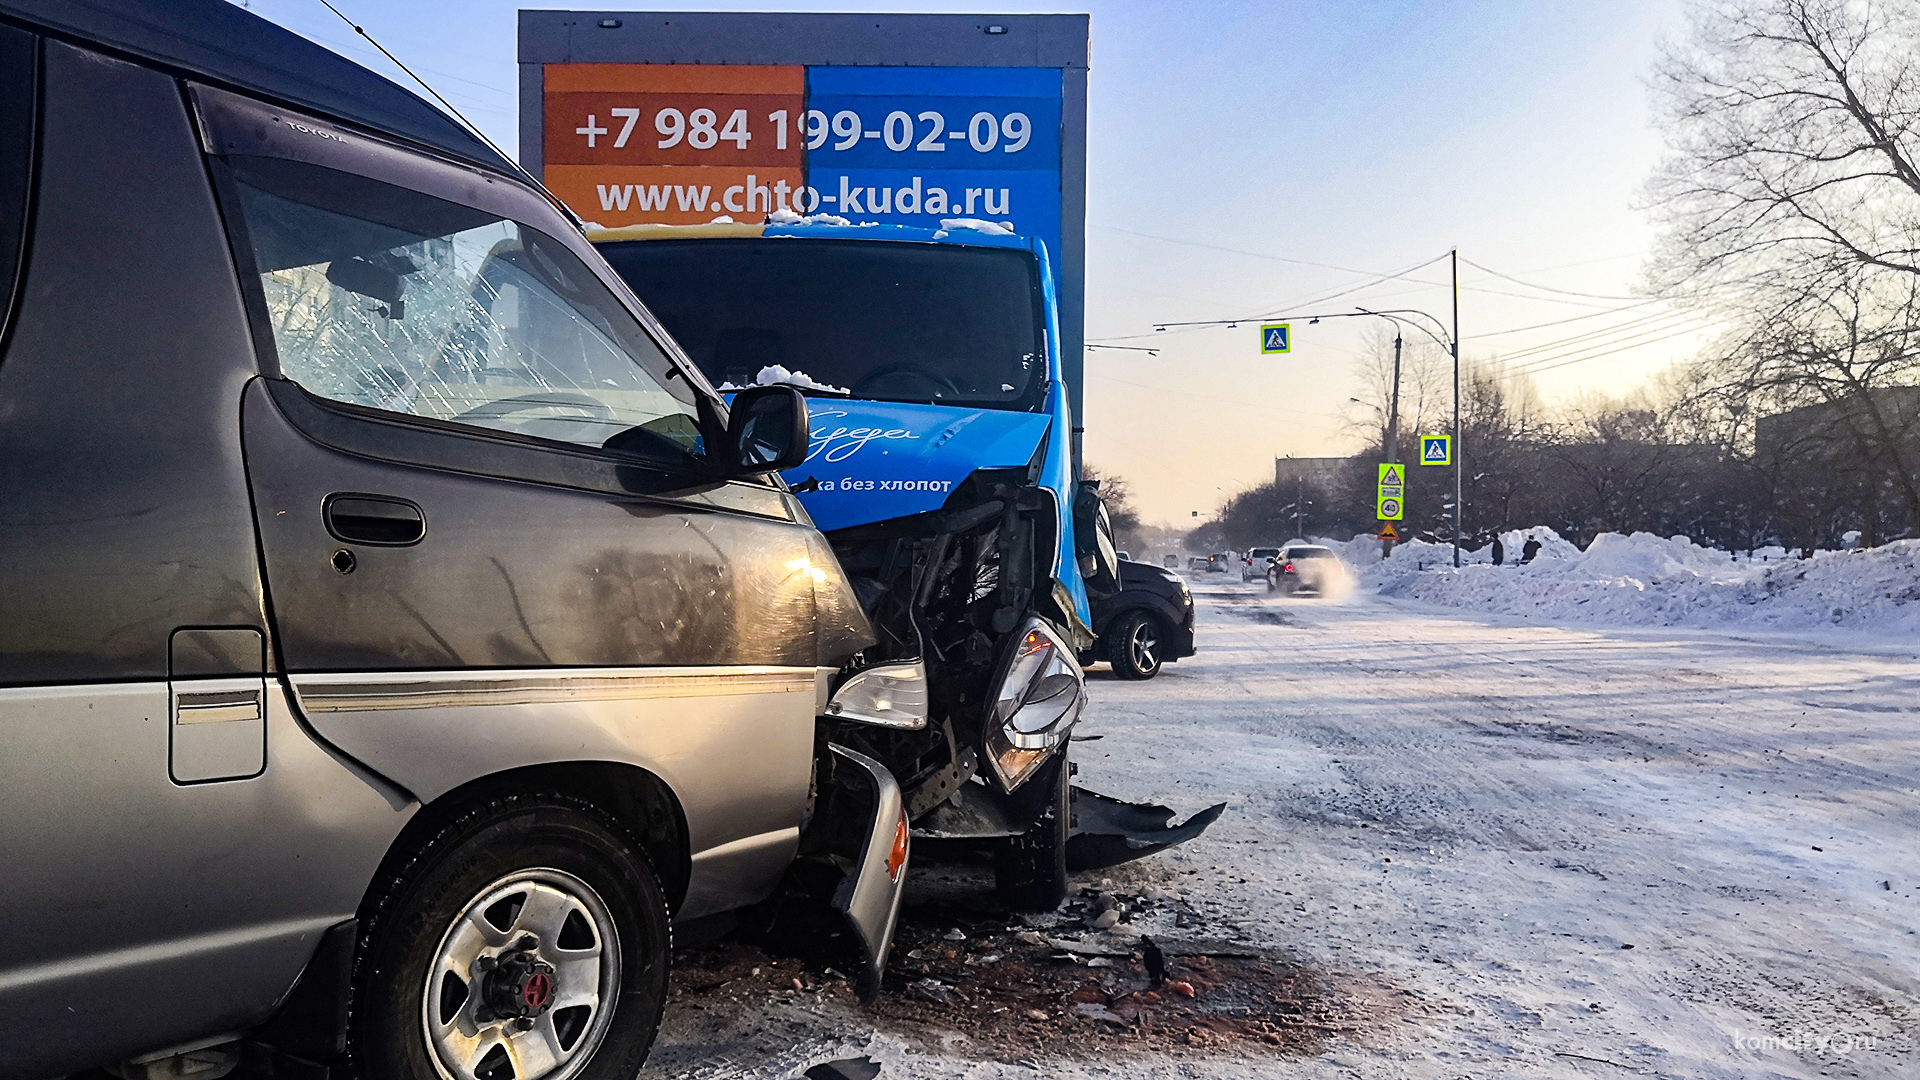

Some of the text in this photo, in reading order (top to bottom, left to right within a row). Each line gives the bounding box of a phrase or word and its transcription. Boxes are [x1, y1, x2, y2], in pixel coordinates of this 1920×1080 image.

[286, 121, 349, 144] TOYOTA
[576, 107, 1032, 153] +7 984 199-02-09
[596, 174, 1010, 215] www.chto-kuda.ru
[840, 477, 875, 491] без
[880, 481, 952, 493] хлопот
[1384, 504, 1396, 512] 40
